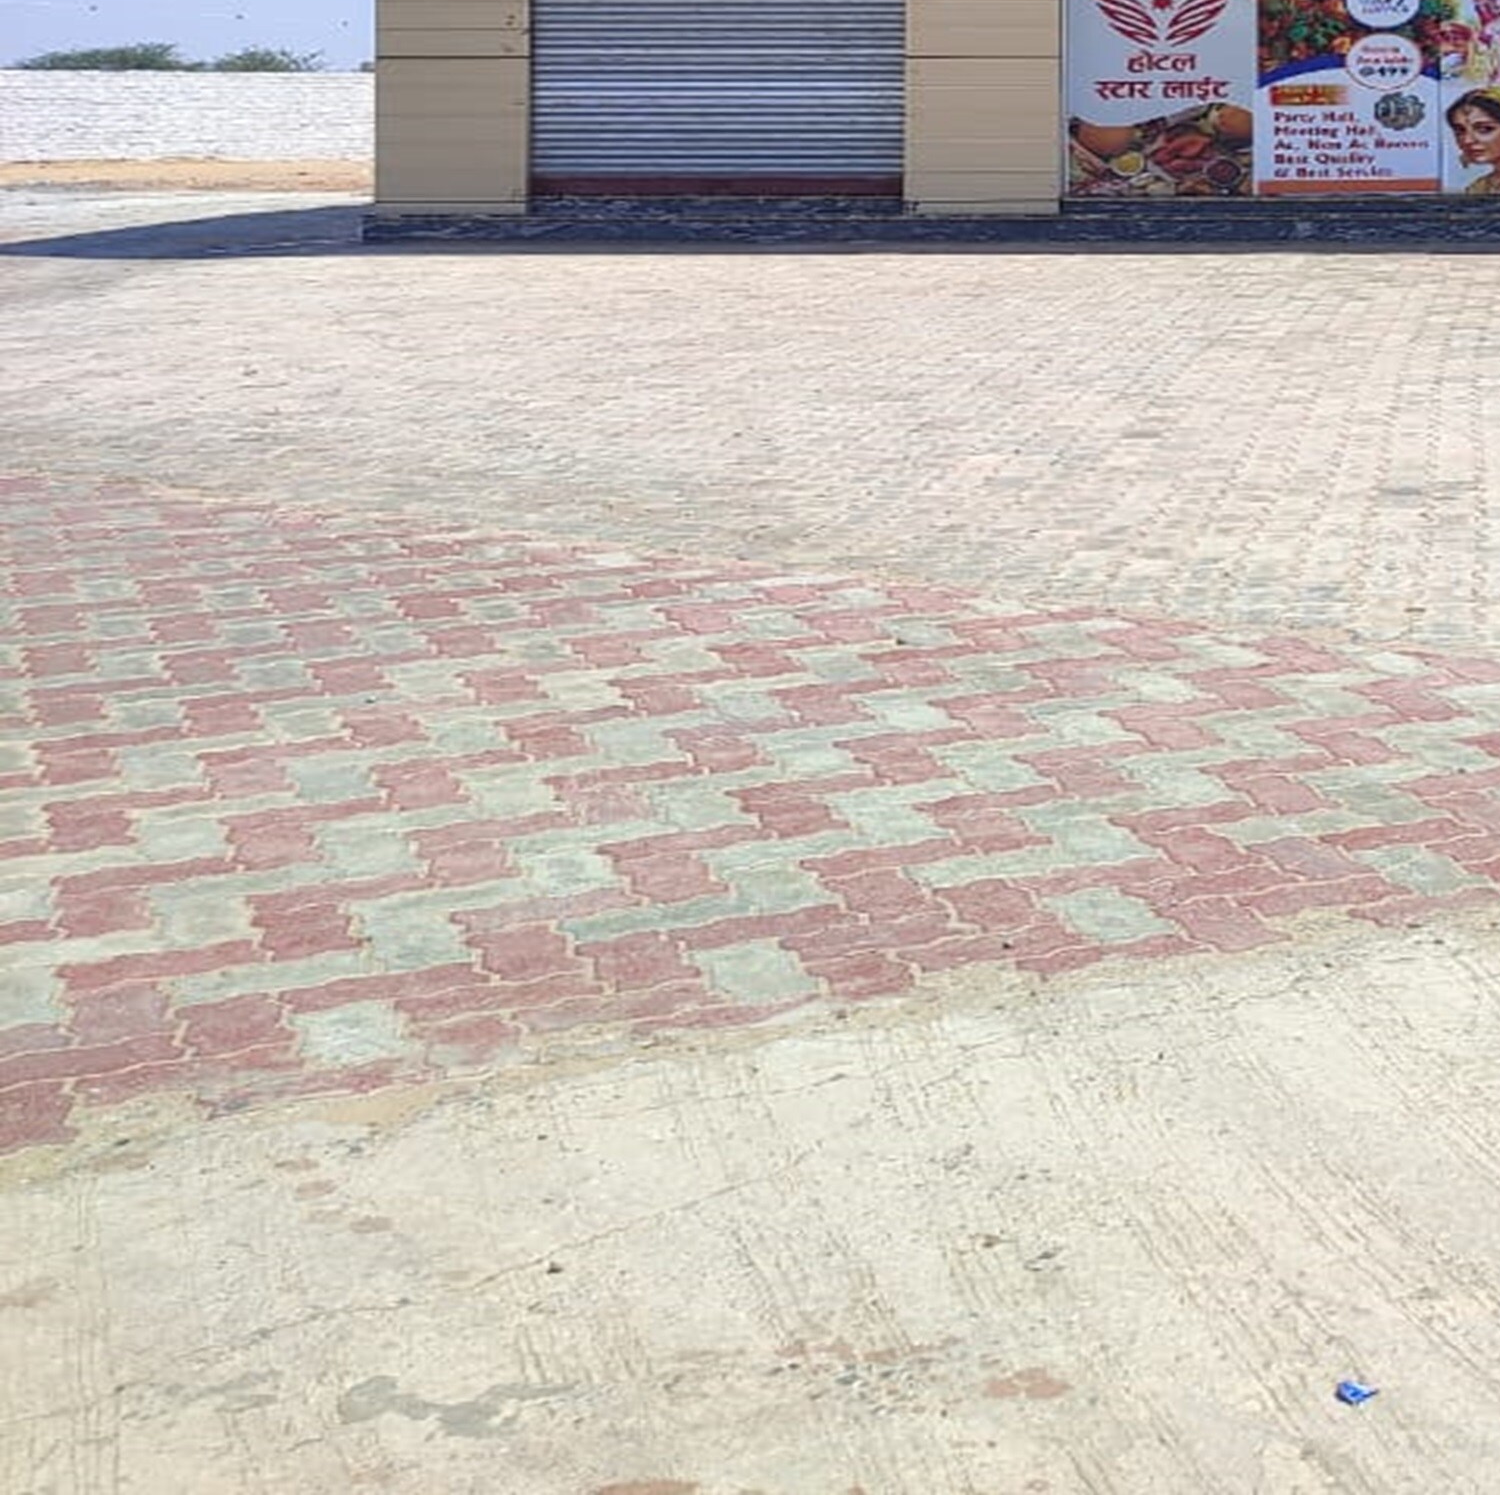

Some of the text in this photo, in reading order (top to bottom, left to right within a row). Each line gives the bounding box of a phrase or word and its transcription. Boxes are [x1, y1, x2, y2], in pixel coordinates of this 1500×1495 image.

[1126, 50, 1197, 73] होटल
[1094, 77, 1231, 101] स्टार लाईट
